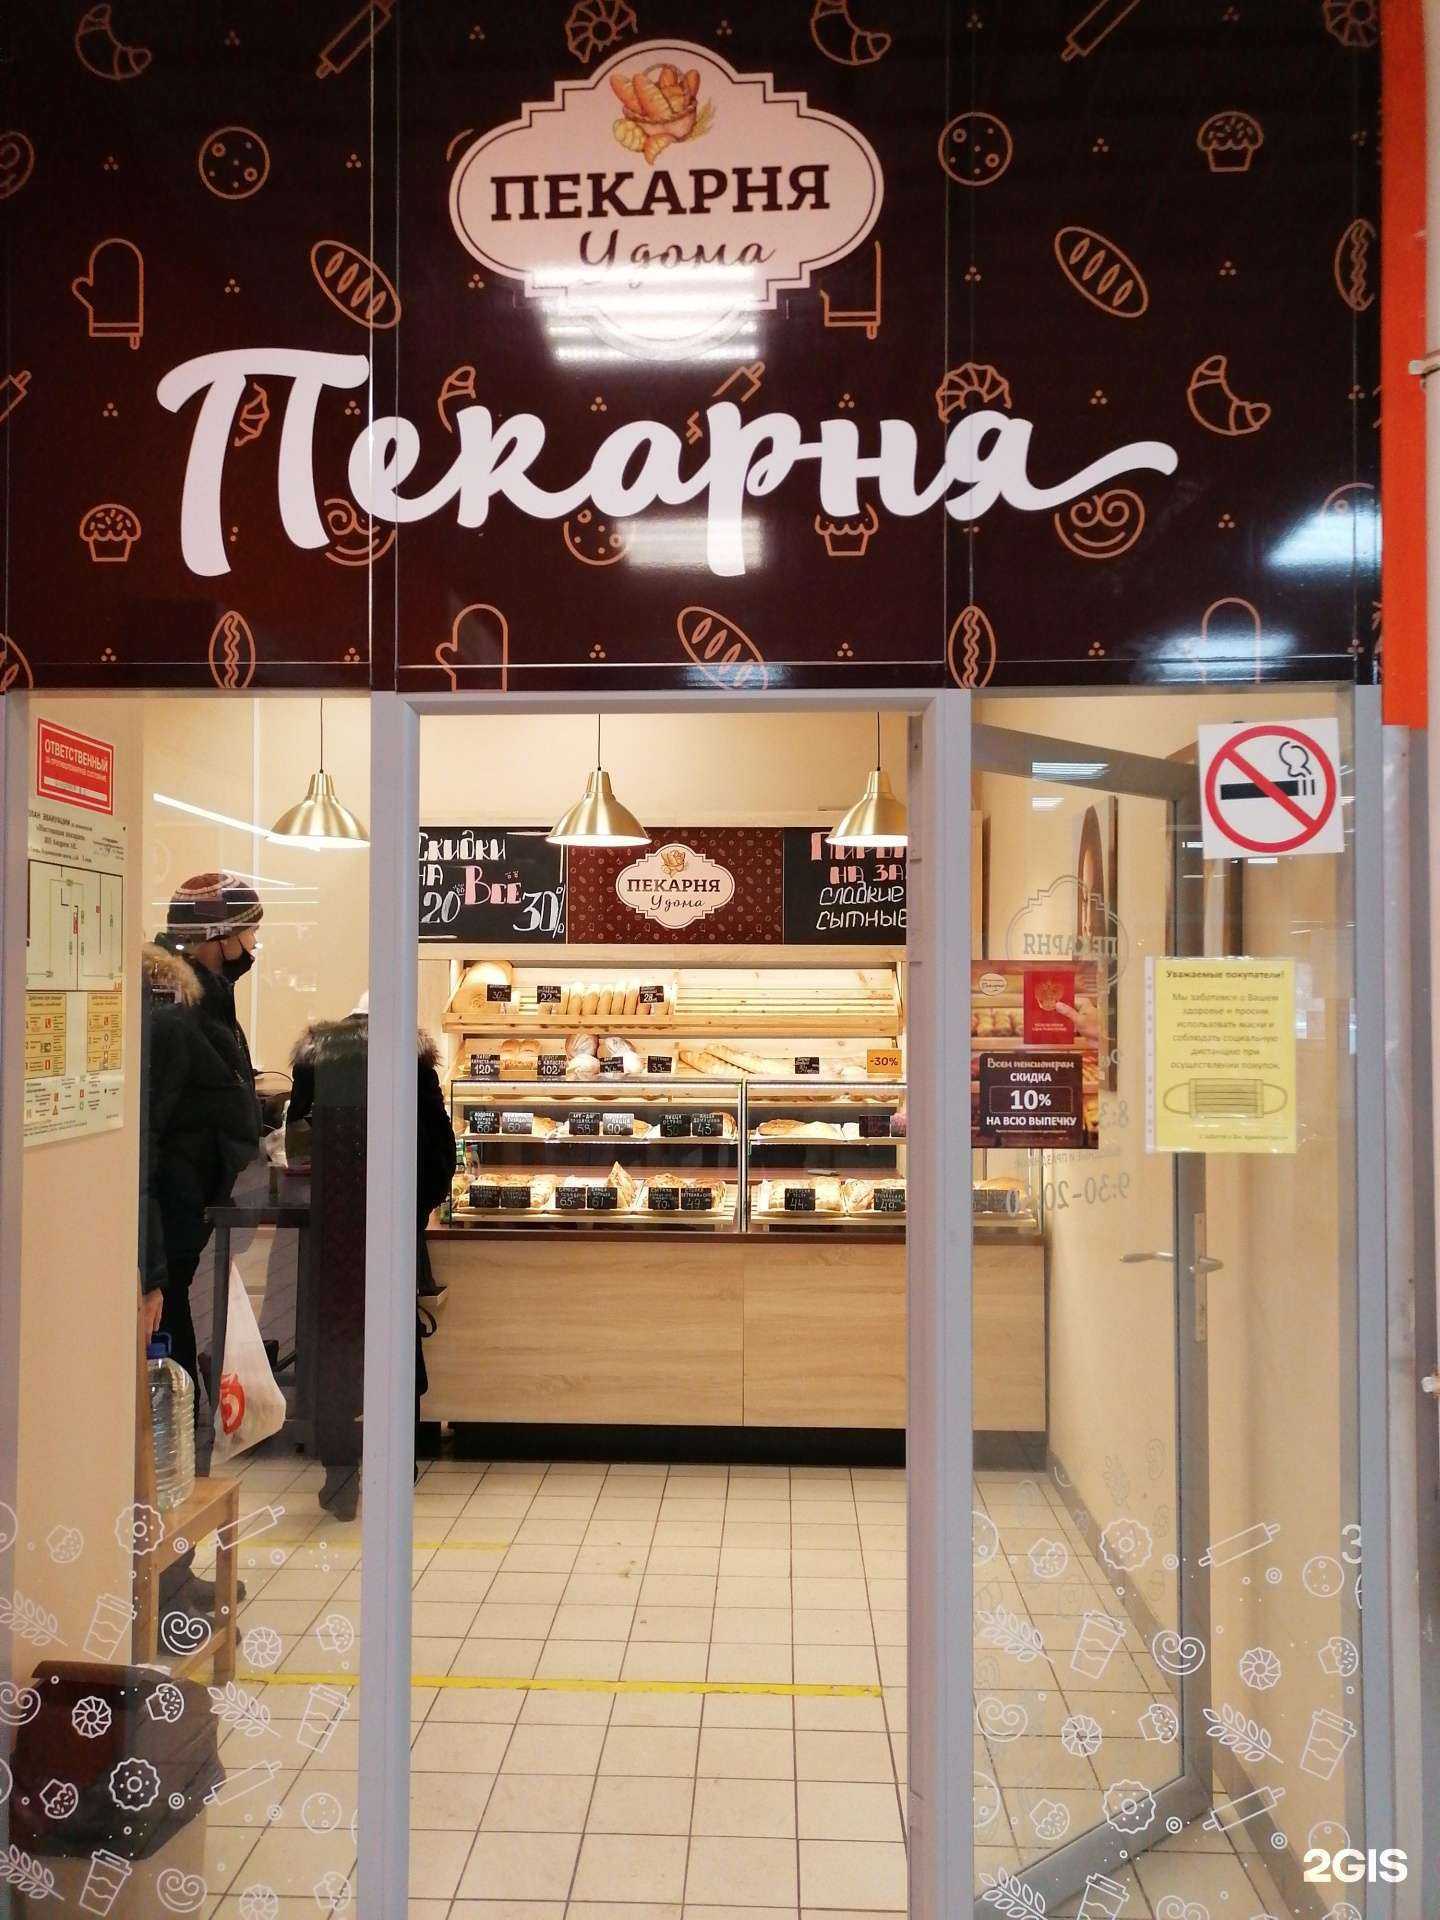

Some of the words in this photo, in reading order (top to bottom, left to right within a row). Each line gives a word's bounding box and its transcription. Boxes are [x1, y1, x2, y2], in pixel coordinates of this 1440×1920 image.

[490, 163, 831, 222] ПЕКАРНЯ
[156, 347, 1180, 577] Пекарня
[45, 738, 109, 773] ОТВЕТСТВЕННЫЙ
[873, 864, 907, 881] ЗА
[627, 879, 721, 892] ПЕКАРНЯ
[513, 884, 566, 939] 30%
[649, 894, 662, 910] У
[664, 899, 705, 912] дома
[1166, 970, 1223, 979] Уважаемые
[869, 1056, 899, 1066] -30%
[987, 1057, 1012, 1069] Всем
[1014, 1059, 1075, 1071] пенсионерам
[1010, 1072, 1052, 1084] СКИДКА
[1010, 1089, 1052, 1110] 10%
[986, 1116, 1001, 1126] НА
[1003, 1116, 1027, 1126] ВСЮ
[1029, 1116, 1077, 1127] ВЫПЕЧКУ
